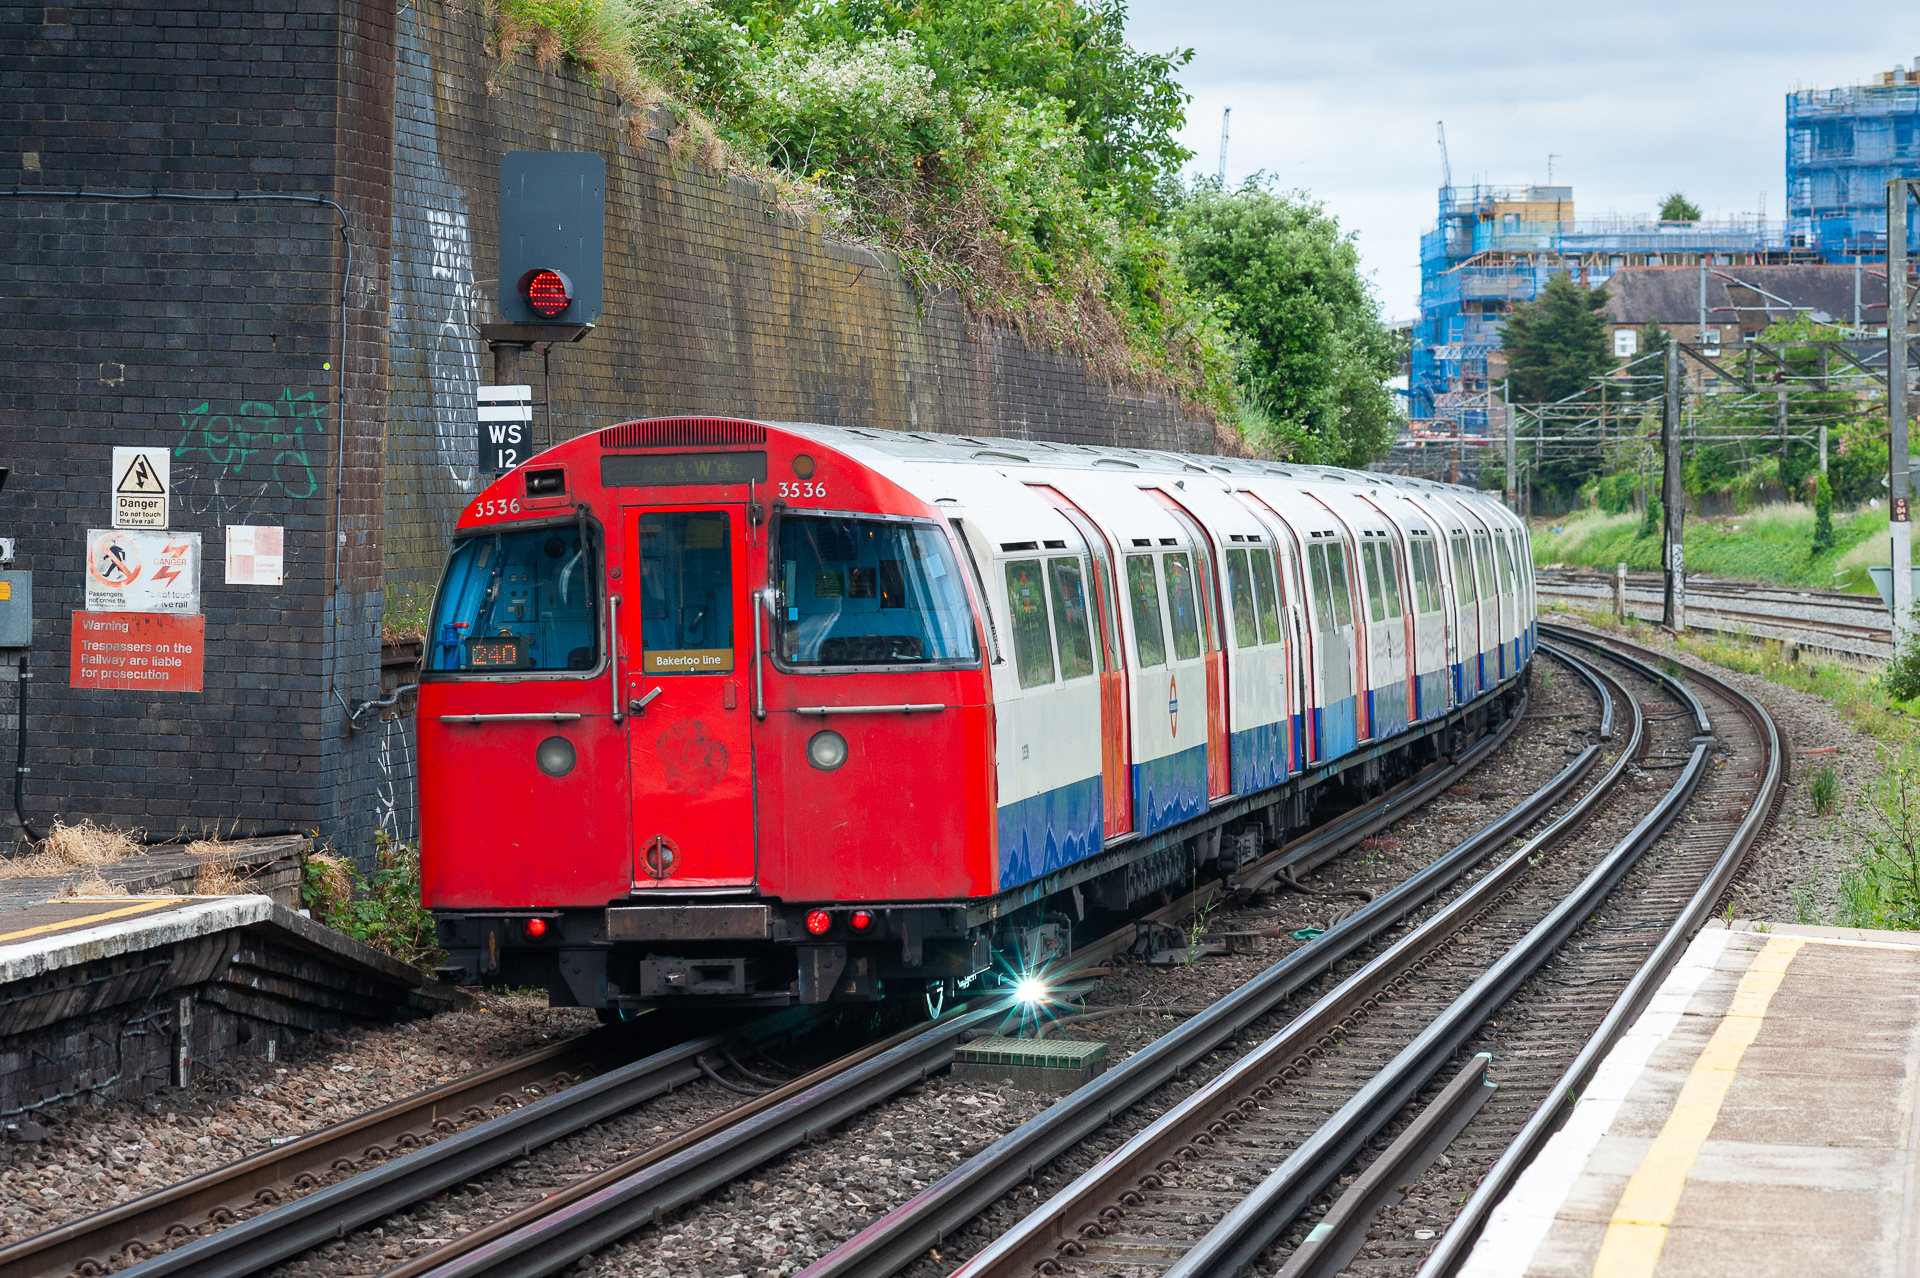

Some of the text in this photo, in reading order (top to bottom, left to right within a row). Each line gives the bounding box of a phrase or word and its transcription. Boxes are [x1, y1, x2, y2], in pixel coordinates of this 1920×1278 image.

[488, 424, 522, 445] WS
[498, 448, 517, 468] 12
[674, 461, 687, 478] &
[778, 481, 827, 498] 3536
[119, 498, 159, 510] Danger
[474, 497, 521, 518] 3536
[153, 558, 187, 566] DANGER
[88, 590, 124, 598] Passengers
[172, 591, 192, 599] touc
[175, 600, 189, 608] rail
[82, 619, 129, 633] Warning
[81, 640, 193, 654] Trespassers on the
[81, 653, 182, 667] Railway are liable
[473, 644, 516, 665] 240
[656, 655, 721, 666] Bakerloo line
[81, 667, 169, 680] for prosecution
